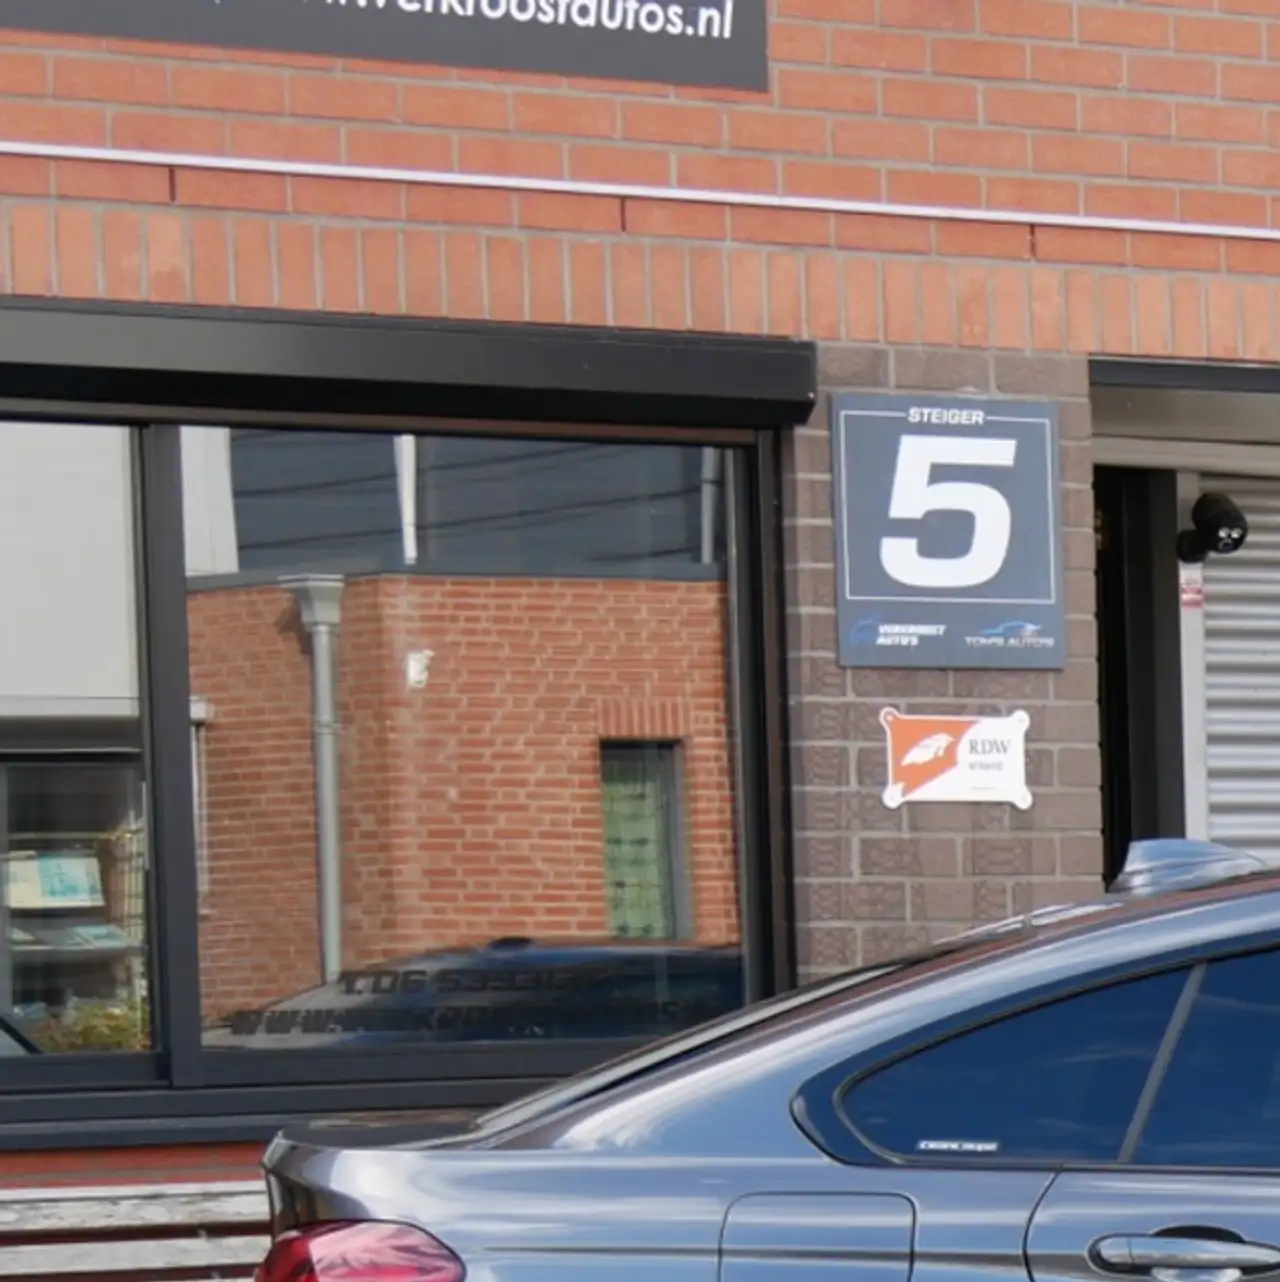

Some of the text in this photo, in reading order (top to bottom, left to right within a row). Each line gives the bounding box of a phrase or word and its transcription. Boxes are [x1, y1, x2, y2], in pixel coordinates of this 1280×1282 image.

[908, 407, 984, 425] STEIGER
[879, 434, 1017, 587] 5
[969, 739, 1011, 755] RDW
